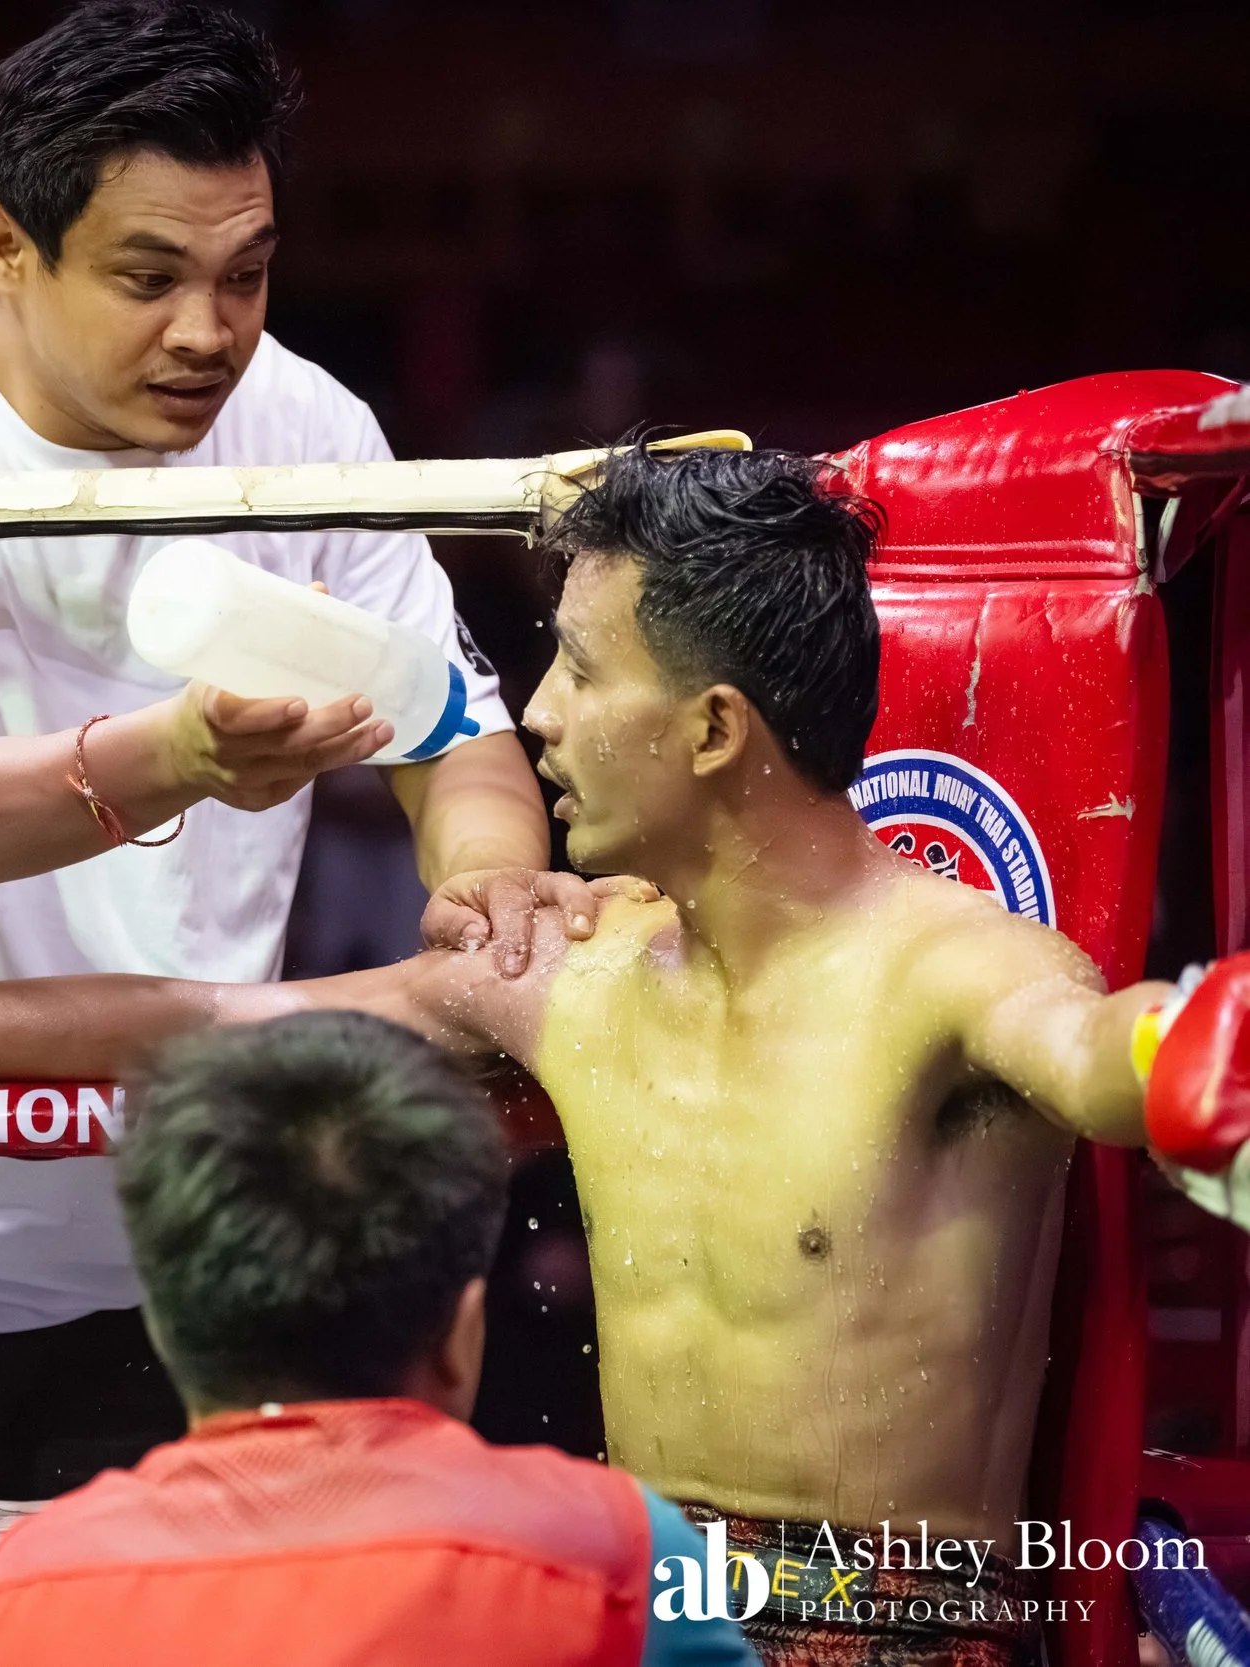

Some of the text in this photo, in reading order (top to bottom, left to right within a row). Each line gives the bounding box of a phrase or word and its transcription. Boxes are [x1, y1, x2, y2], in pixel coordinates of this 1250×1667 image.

[847, 770, 930, 812] NATIONAL
[932, 773, 979, 815] MUAY
[974, 796, 1012, 849] THAI
